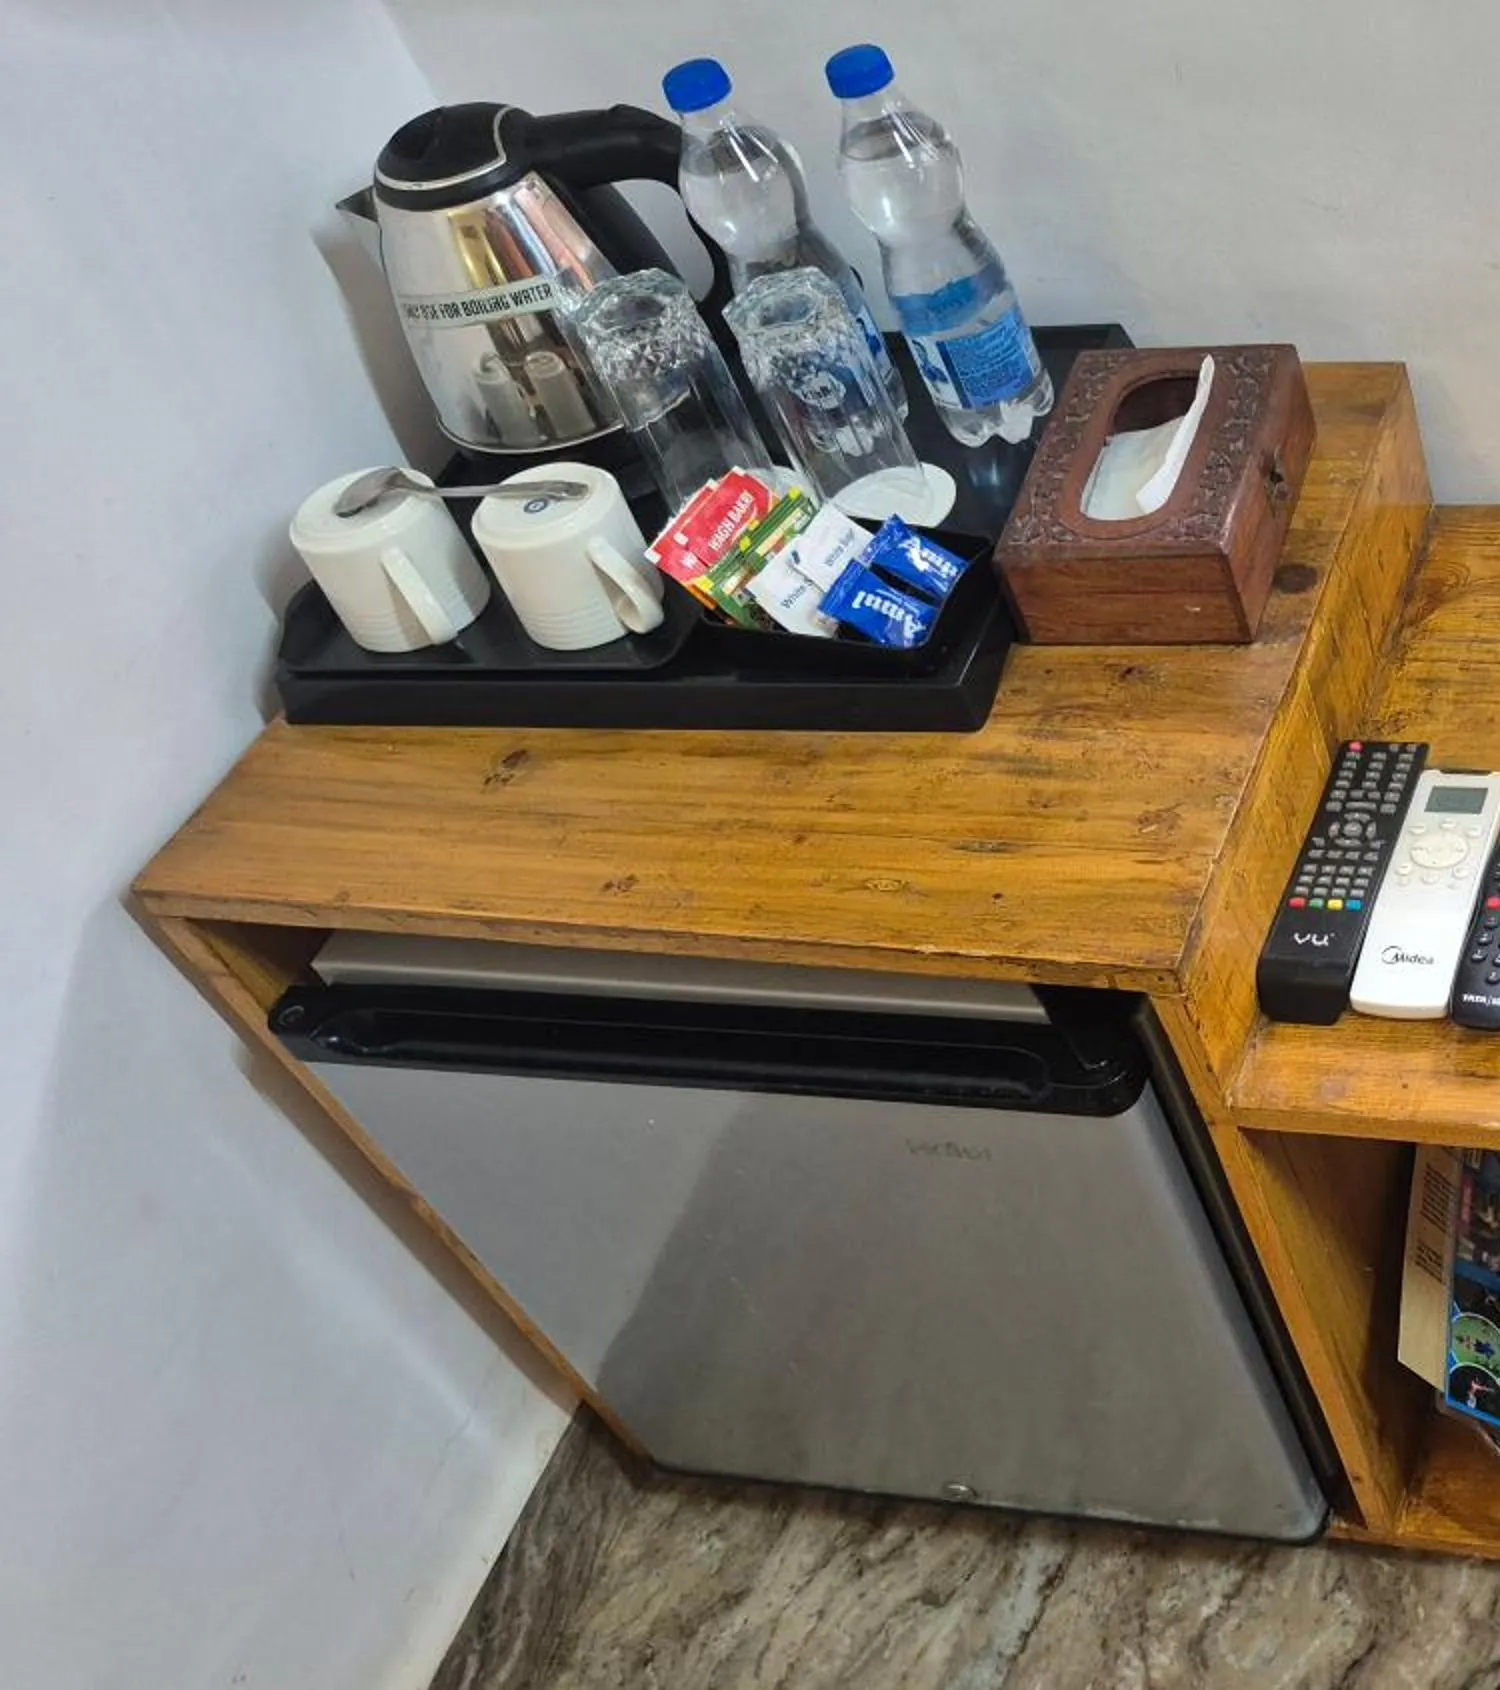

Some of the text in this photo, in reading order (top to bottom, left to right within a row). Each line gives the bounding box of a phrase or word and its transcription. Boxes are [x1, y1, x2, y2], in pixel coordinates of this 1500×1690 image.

[440, 301, 463, 320] FOR
[462, 294, 511, 317] BOILING
[510, 283, 553, 308] WATER
[851, 590, 927, 640] Amul
[1384, 947, 1435, 966] Midea
